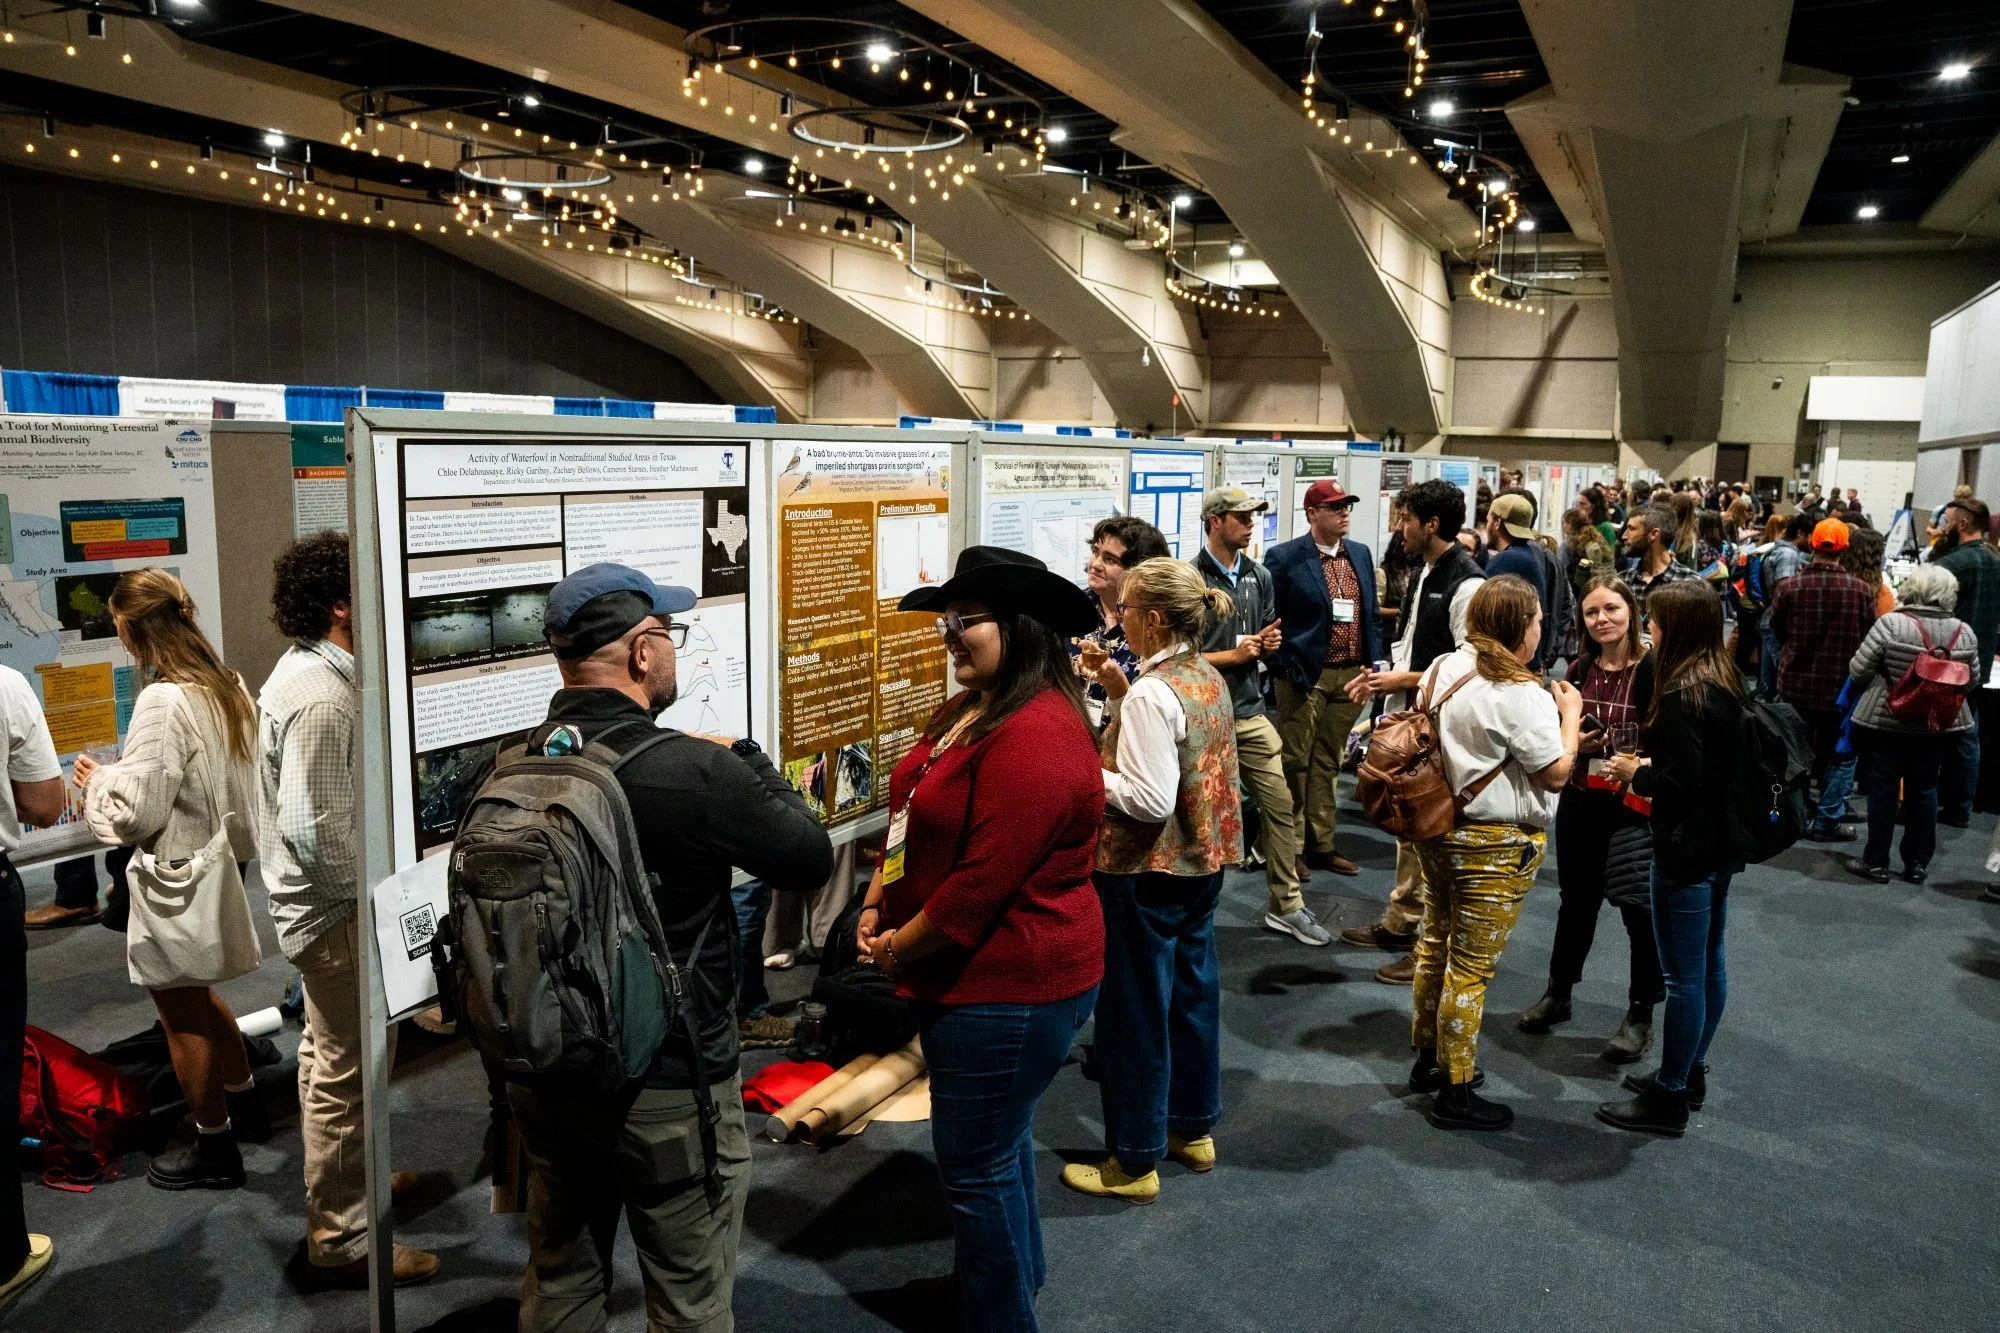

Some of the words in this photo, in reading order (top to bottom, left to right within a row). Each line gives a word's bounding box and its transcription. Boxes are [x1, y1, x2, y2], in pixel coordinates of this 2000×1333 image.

[169, 397, 190, 406] Society
[5, 422, 32, 430] Tool
[34, 422, 48, 430] for
[52, 422, 109, 432] Monitoring
[112, 423, 159, 432] Terrestrial
[31, 435, 90, 446] Biodiversity
[468, 453, 499, 464] Activity
[501, 453, 511, 462] of
[511, 453, 548, 462] Waterfowl
[551, 453, 556, 461] in
[560, 453, 606, 461] Nontraditional
[608, 452, 632, 461] Studied
[633, 453, 650, 461] Areas
[660, 453, 676, 461] Texas
[807, 449, 812, 457] A
[898, 451, 917, 459] grasses
[816, 462, 846, 471] imperiled
[848, 462, 878, 471] shortgrass
[879, 462, 896, 471] prairie
[897, 461, 924, 471] songbirds?
[438, 468, 457, 477] Chloe
[460, 467, 505, 477] Delahoussaye,
[507, 467, 524, 476] Ricky
[526, 467, 551, 476] Garibay,
[553, 466, 576, 475] Zachary
[578, 466, 601, 474] Bellows,
[881, 504, 914, 513] Preliminary
[916, 503, 936, 512] Results
[785, 508, 832, 519] Introduction
[20, 529, 60, 538] Objectives
[788, 617, 810, 625] Research
[787, 652, 820, 666] Methods
[801, 663, 824, 672] Collection:
[830, 665, 851, 675] Wheatland
[880, 679, 910, 692] Discussion
[794, 690, 817, 699] Established
[879, 727, 914, 744] Significance
[412, 946, 428, 957] SCAN
